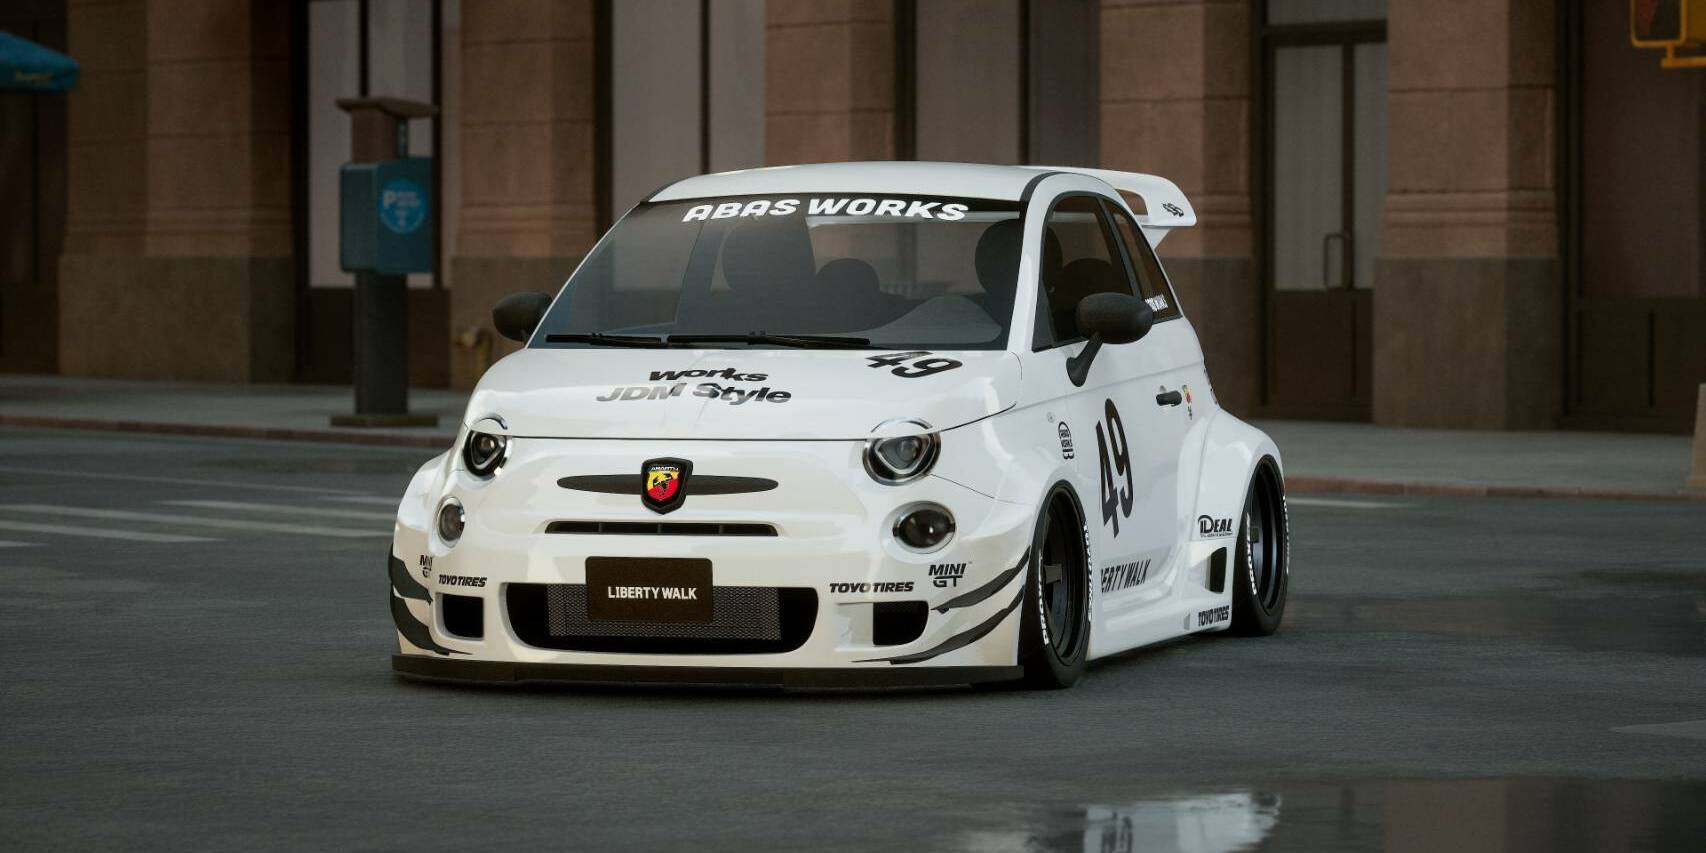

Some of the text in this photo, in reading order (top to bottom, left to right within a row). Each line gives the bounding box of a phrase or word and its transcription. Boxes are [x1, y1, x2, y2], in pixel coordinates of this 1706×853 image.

[682, 199, 969, 222] ABAS WORKS
[865, 351, 963, 378] 49
[596, 383, 791, 405] JDM Style
[1095, 399, 1134, 539] 49
[928, 563, 966, 576] MINI
[1101, 563, 1128, 593] ERTY
[932, 575, 963, 588] GT
[607, 586, 697, 600] LIBERTY WALK
